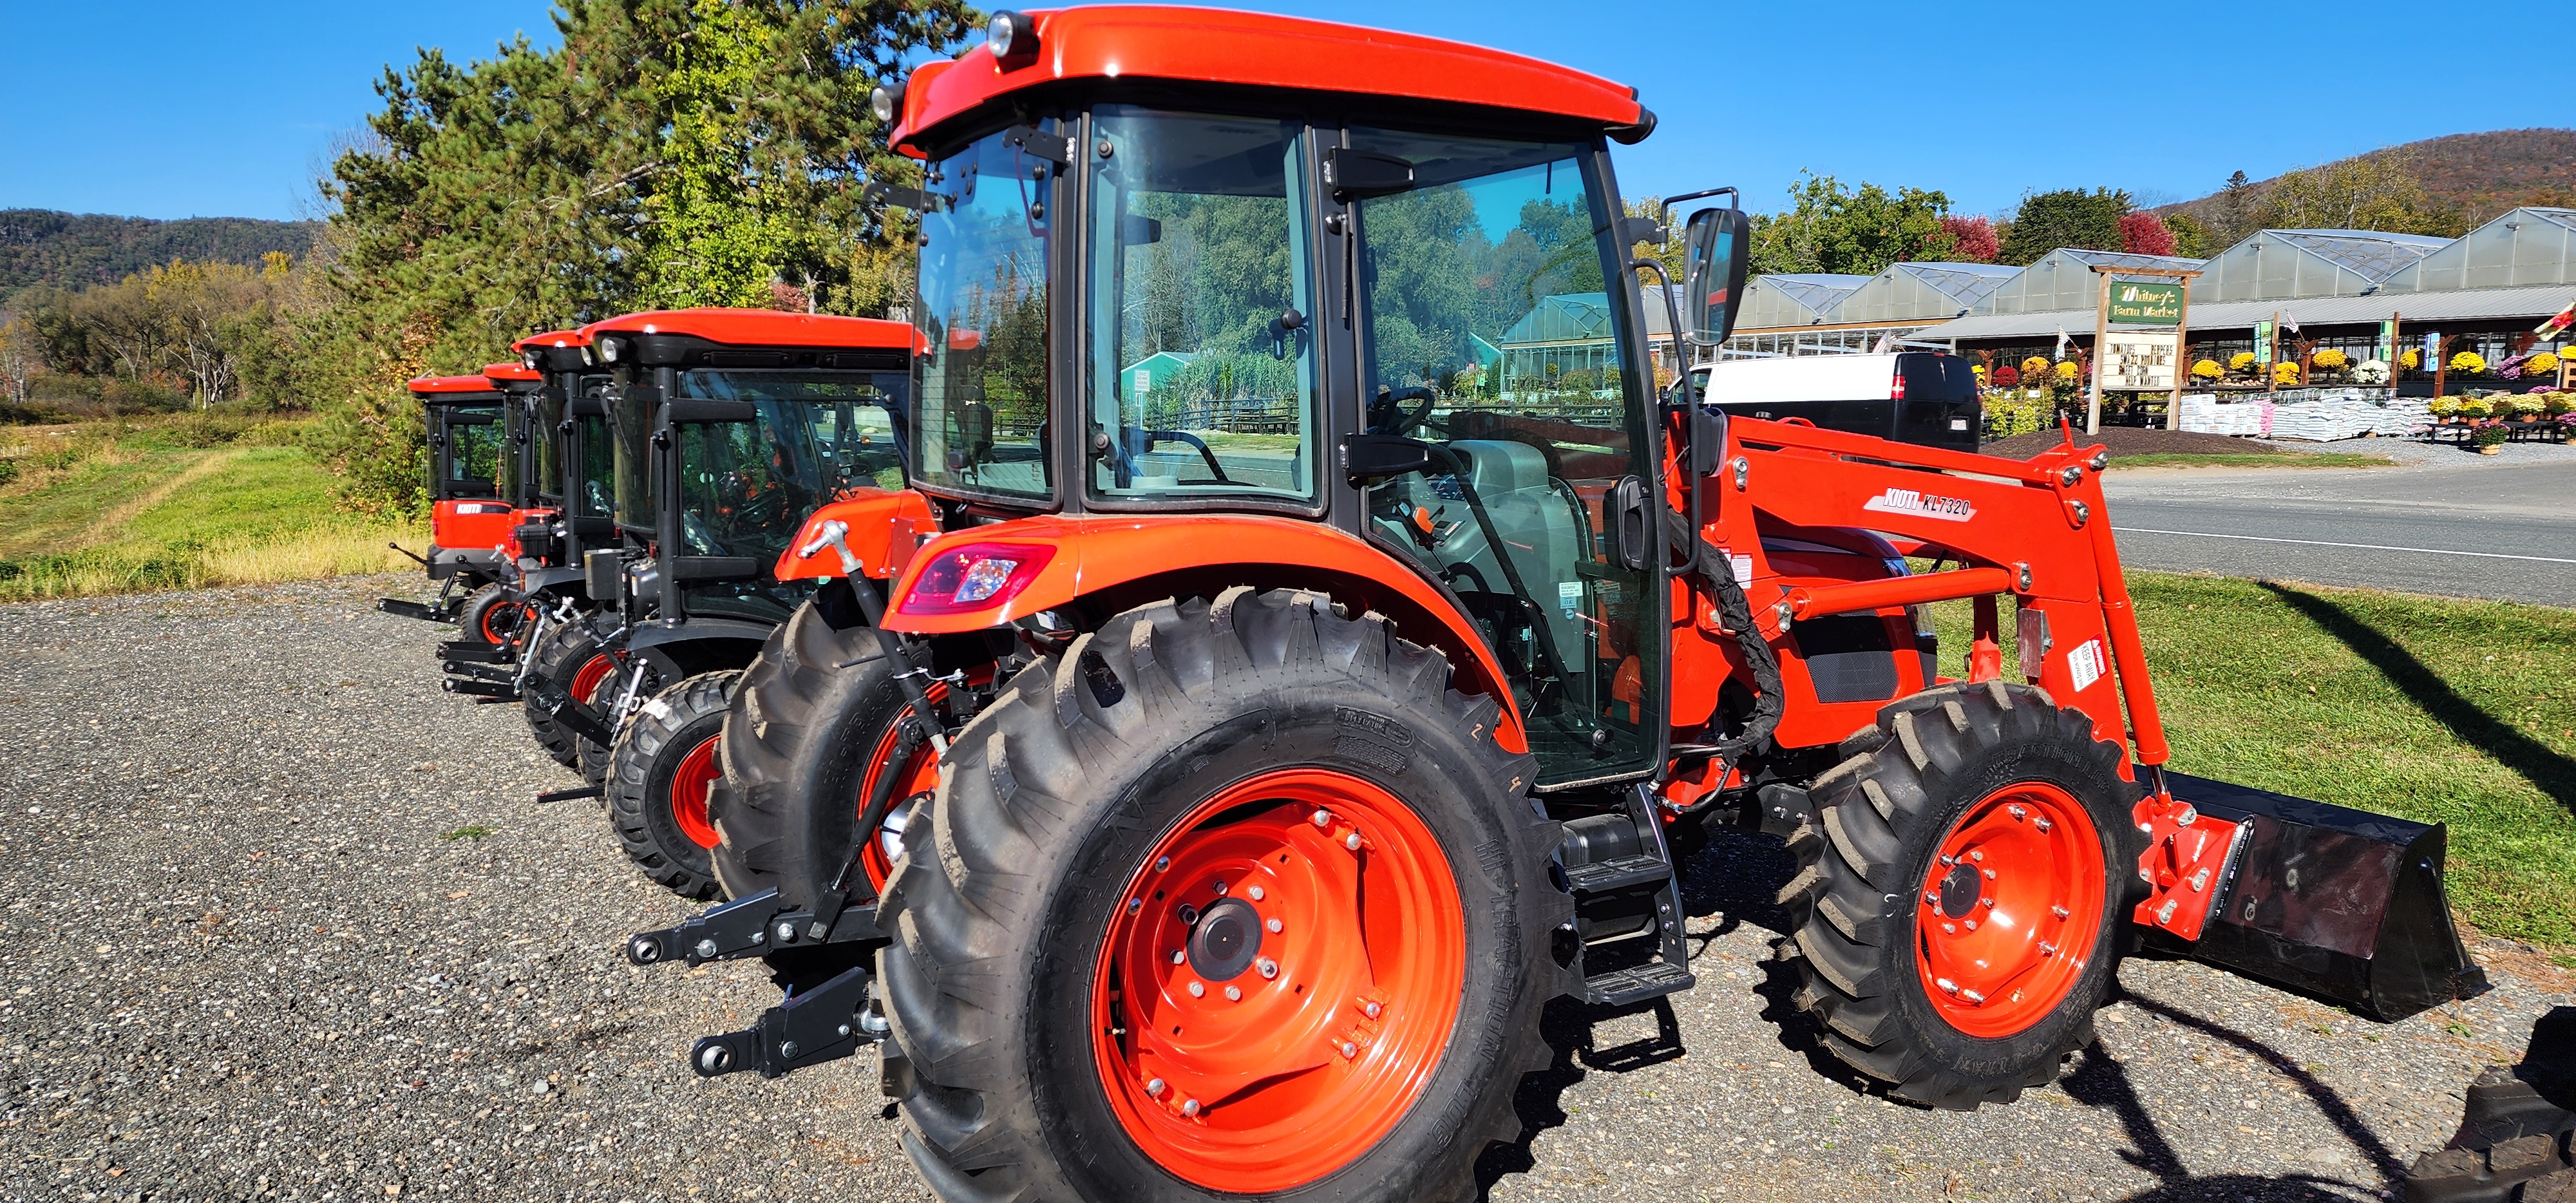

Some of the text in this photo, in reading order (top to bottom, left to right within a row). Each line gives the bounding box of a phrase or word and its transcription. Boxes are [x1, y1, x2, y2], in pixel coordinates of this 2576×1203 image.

[2114, 305, 2179, 317] Farm Market
[2110, 343, 2136, 355] TOMATOES
[2151, 345, 2173, 355] PEPPERS
[2125, 375, 2160, 386] HELP WANTED
[1883, 488, 1971, 516] KIOTI KL7320
[457, 504, 482, 514] KIOTI
[2081, 644, 2095, 681] KEEP AWAY
[1431, 1079, 1479, 1148] LUG
